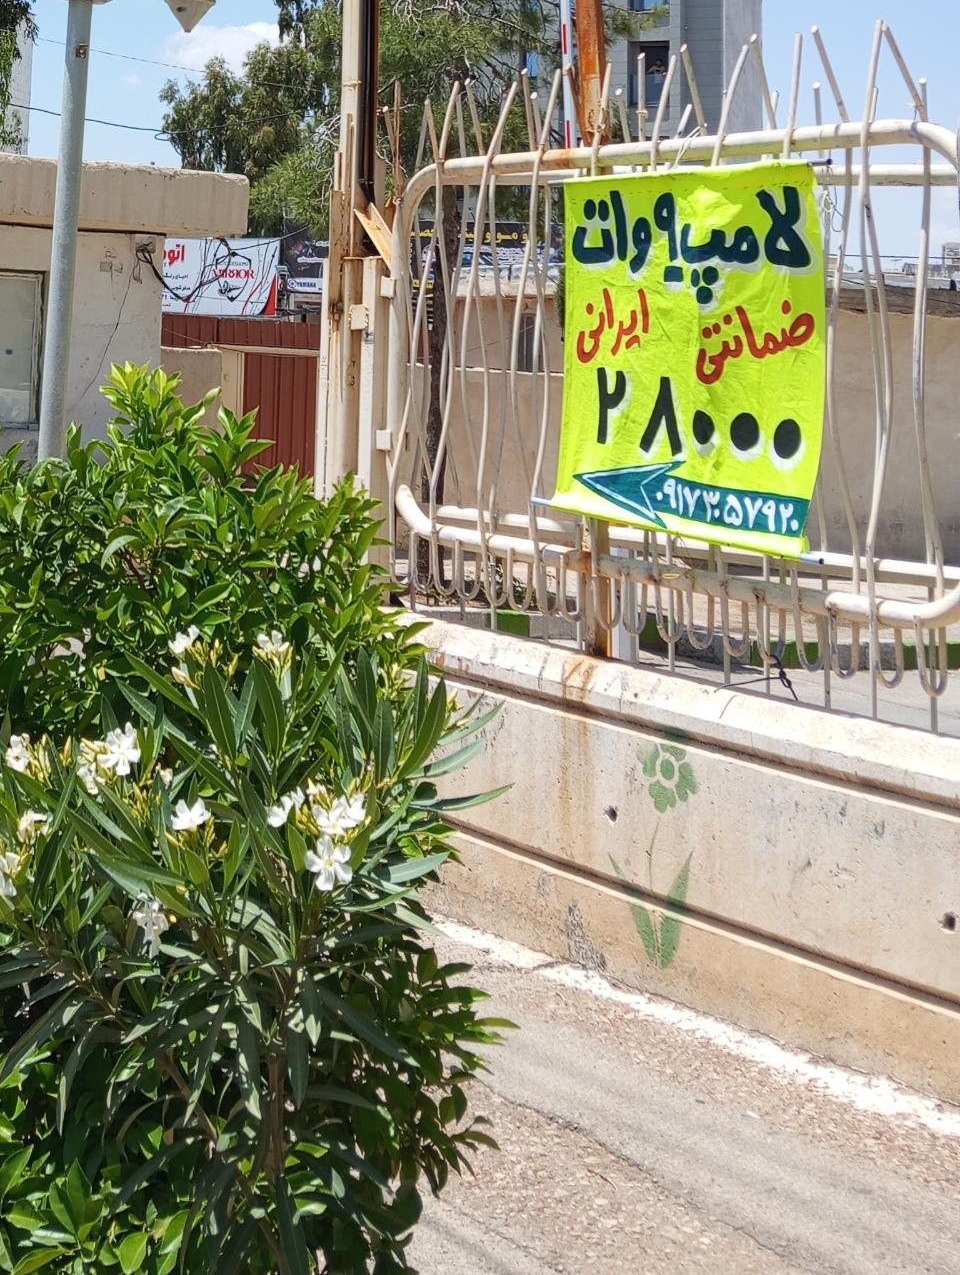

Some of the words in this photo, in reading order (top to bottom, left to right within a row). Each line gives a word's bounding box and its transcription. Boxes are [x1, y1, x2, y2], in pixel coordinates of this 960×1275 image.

[572, 189, 653, 275] وات
[680, 185, 812, 306] لامپ
[575, 287, 650, 364] ایرانی
[695, 298, 816, 385] ضمانتی
[596, 366, 803, 460] ۲۸۰۰۰
